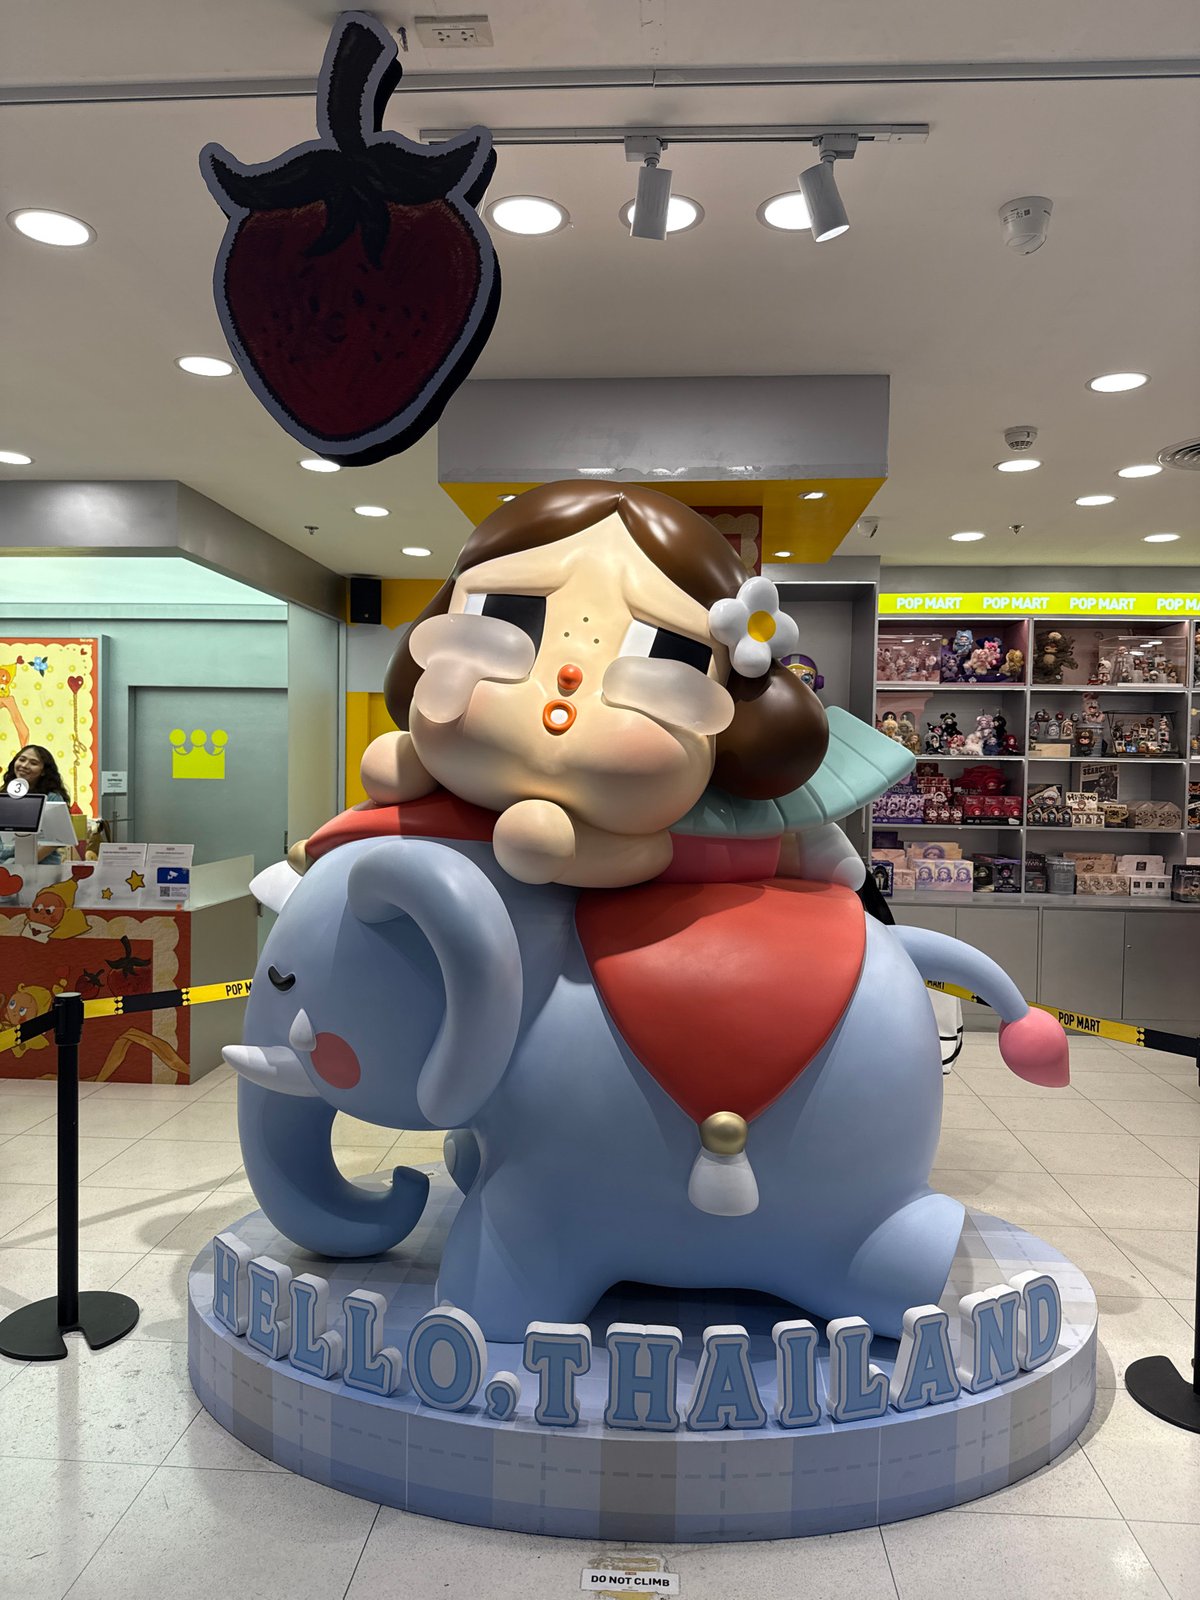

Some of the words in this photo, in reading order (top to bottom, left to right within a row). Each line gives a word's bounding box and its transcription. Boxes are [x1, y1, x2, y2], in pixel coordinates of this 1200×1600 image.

[896, 597, 923, 610] POP
[924, 597, 963, 610] MART
[983, 597, 1010, 610] POP
[1011, 597, 1050, 610] MART
[1069, 597, 1096, 610] POP
[1098, 597, 1137, 610] MART
[1156, 598, 1184, 611] POP
[14, 782, 22, 794] 3
[225, 983, 243, 997] POP
[1058, 1011, 1075, 1026] POP
[1076, 1016, 1101, 1034] MART
[523, 1270, 1063, 1431] THAILAND
[591, 1575, 607, 1583] DO
[608, 1576, 632, 1585] NOT
[634, 1577, 670, 1587] CLIMB
